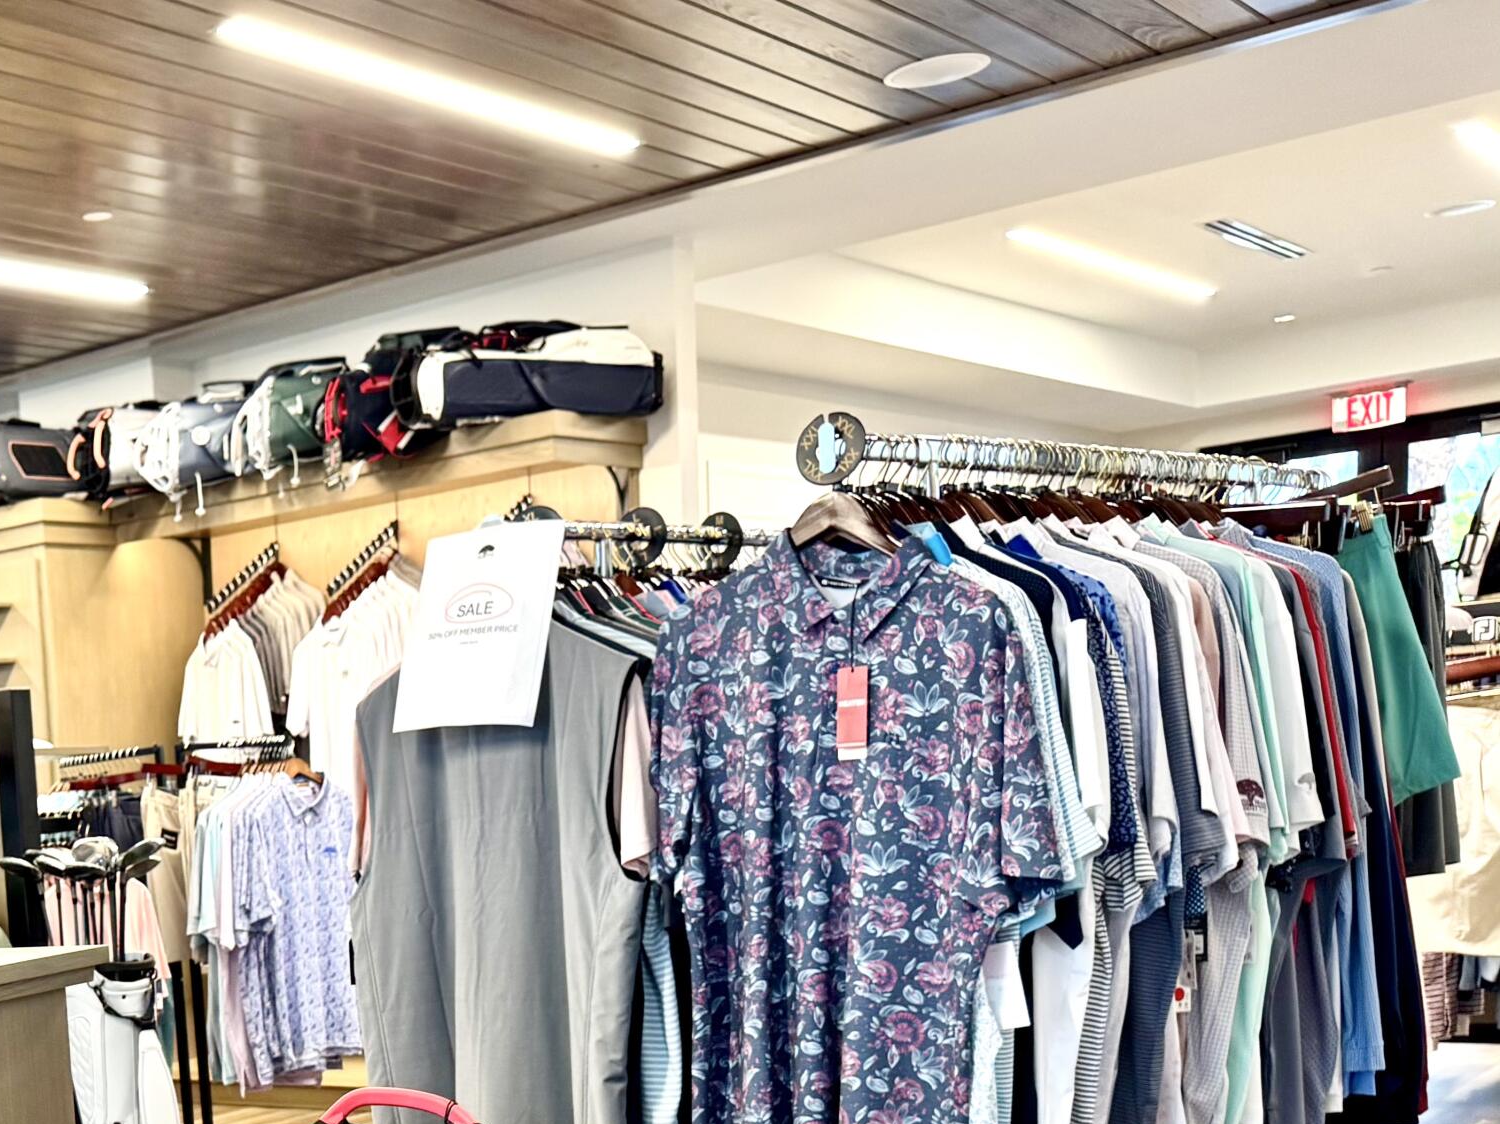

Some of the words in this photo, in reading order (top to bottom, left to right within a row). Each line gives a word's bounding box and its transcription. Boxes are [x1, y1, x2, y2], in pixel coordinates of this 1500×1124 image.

[1347, 390, 1393, 428] EXIT
[457, 600, 494, 618] SALE
[444, 629, 458, 639] OFF
[459, 626, 493, 636] MEMBER
[494, 624, 519, 633] PRICE
